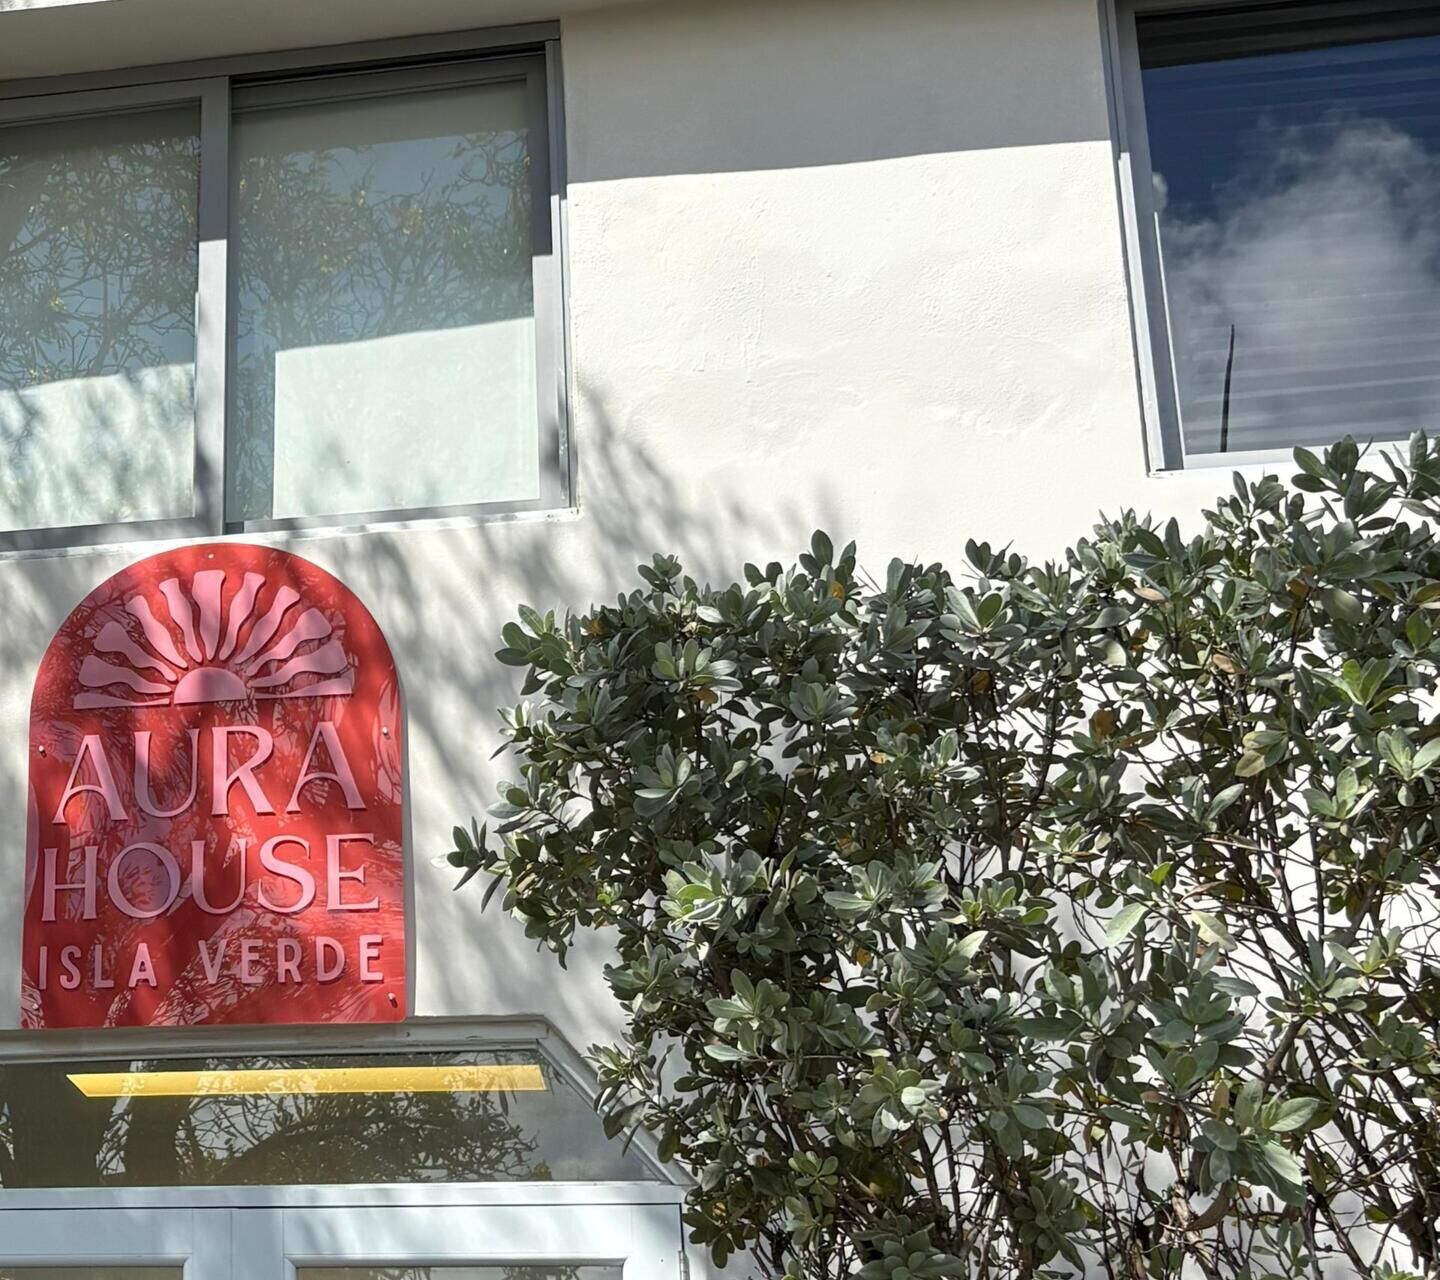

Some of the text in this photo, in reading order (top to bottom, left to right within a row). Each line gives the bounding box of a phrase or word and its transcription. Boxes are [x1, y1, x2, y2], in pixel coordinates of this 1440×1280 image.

[53, 721, 367, 823] AURA
[41, 833, 380, 921] HOUSE
[38, 934, 384, 991] ISLA VERDE
